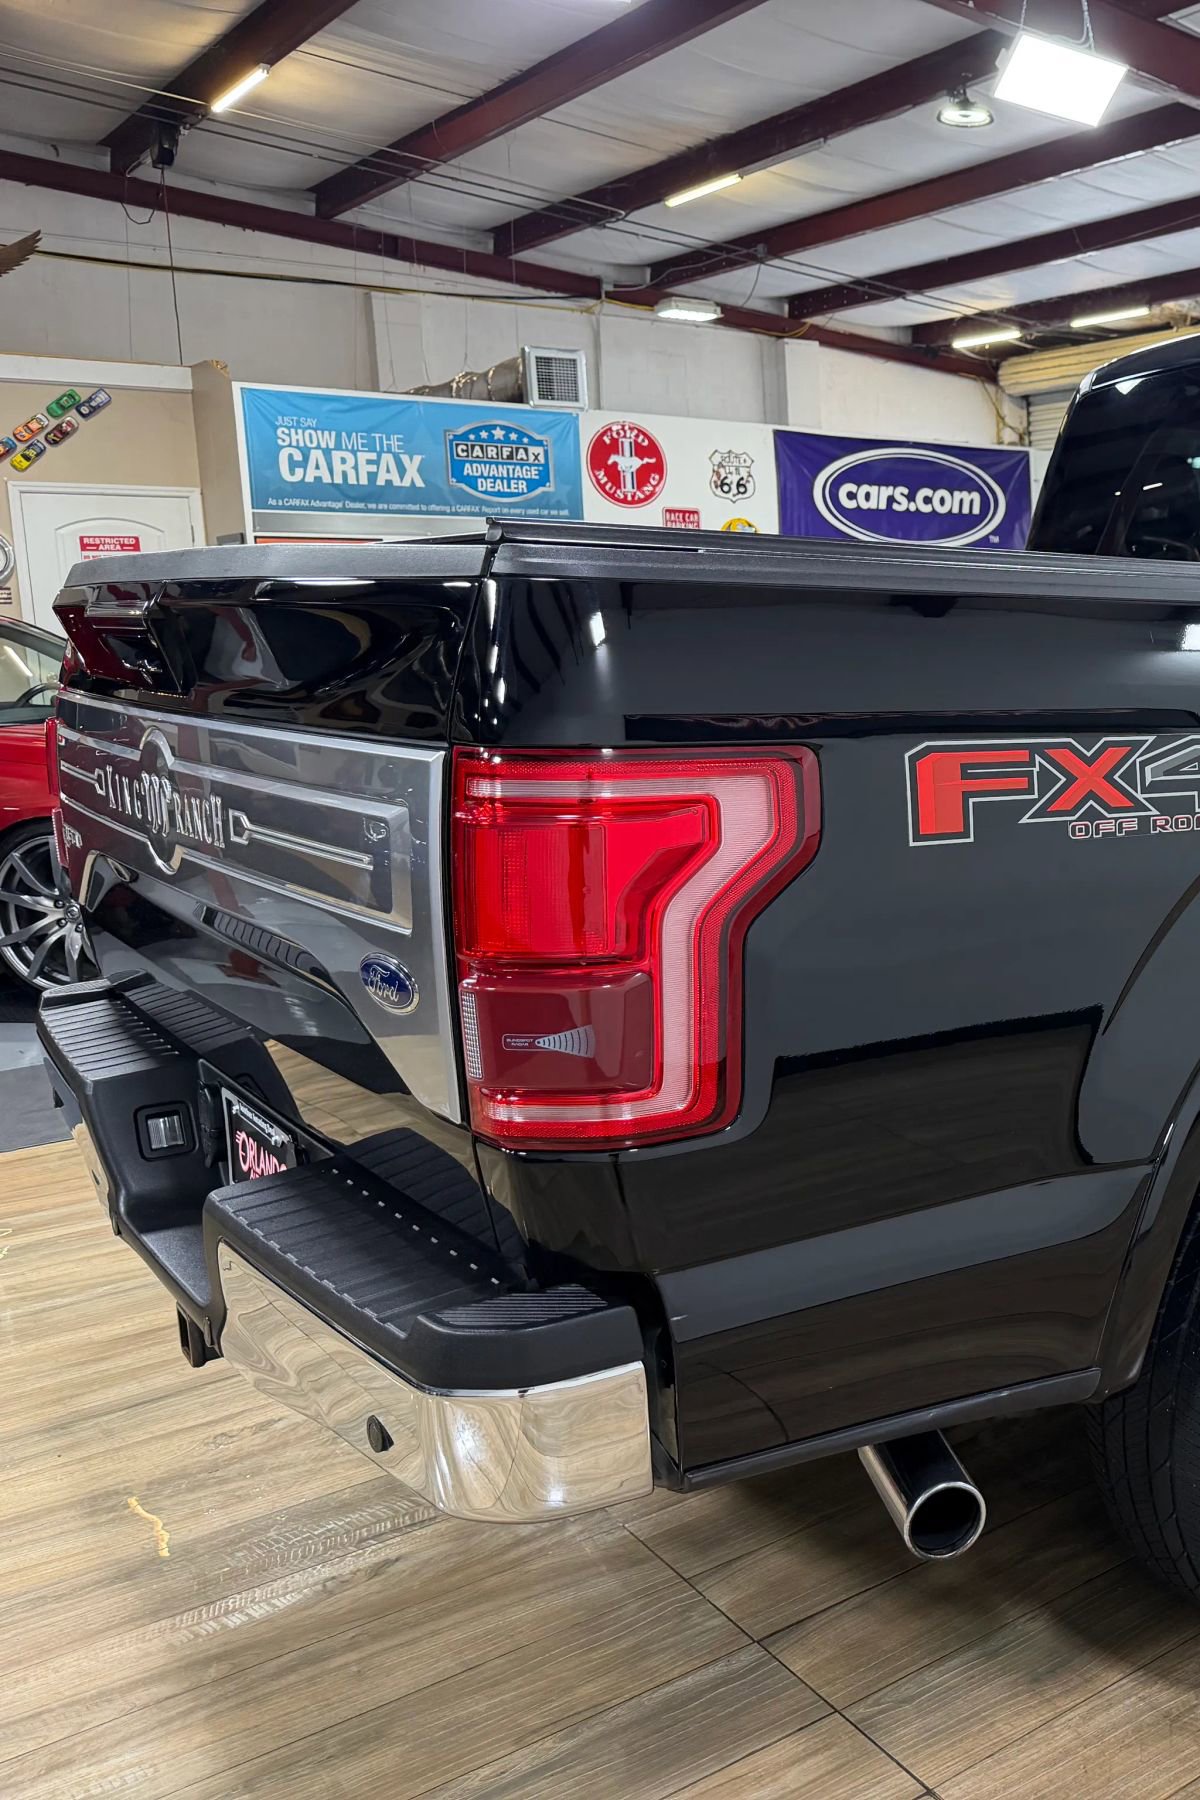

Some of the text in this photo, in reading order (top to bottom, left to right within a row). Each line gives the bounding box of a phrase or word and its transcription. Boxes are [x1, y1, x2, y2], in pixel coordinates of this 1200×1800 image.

[275, 416, 317, 428] JUST SAY
[277, 427, 405, 453] SHOW ME THE
[602, 428, 649, 447] FORD
[456, 444, 541, 463] CARFAX
[278, 447, 425, 487] CARFAX
[463, 463, 540, 479] ADVANTAGE
[477, 478, 528, 493] DEALER
[594, 468, 660, 501] MUSTANG
[720, 476, 747, 495] 66
[268, 497, 277, 506] As
[284, 498, 309, 507] CARFAX
[838, 482, 981, 515] cars.com
[665, 511, 699, 522] RACE CAR
[83, 537, 136, 545] RESTRICTED
[106, 764, 226, 849] KING RANCH
[1068, 817, 1138, 840] OFF
[368, 964, 400, 1002] Ford
